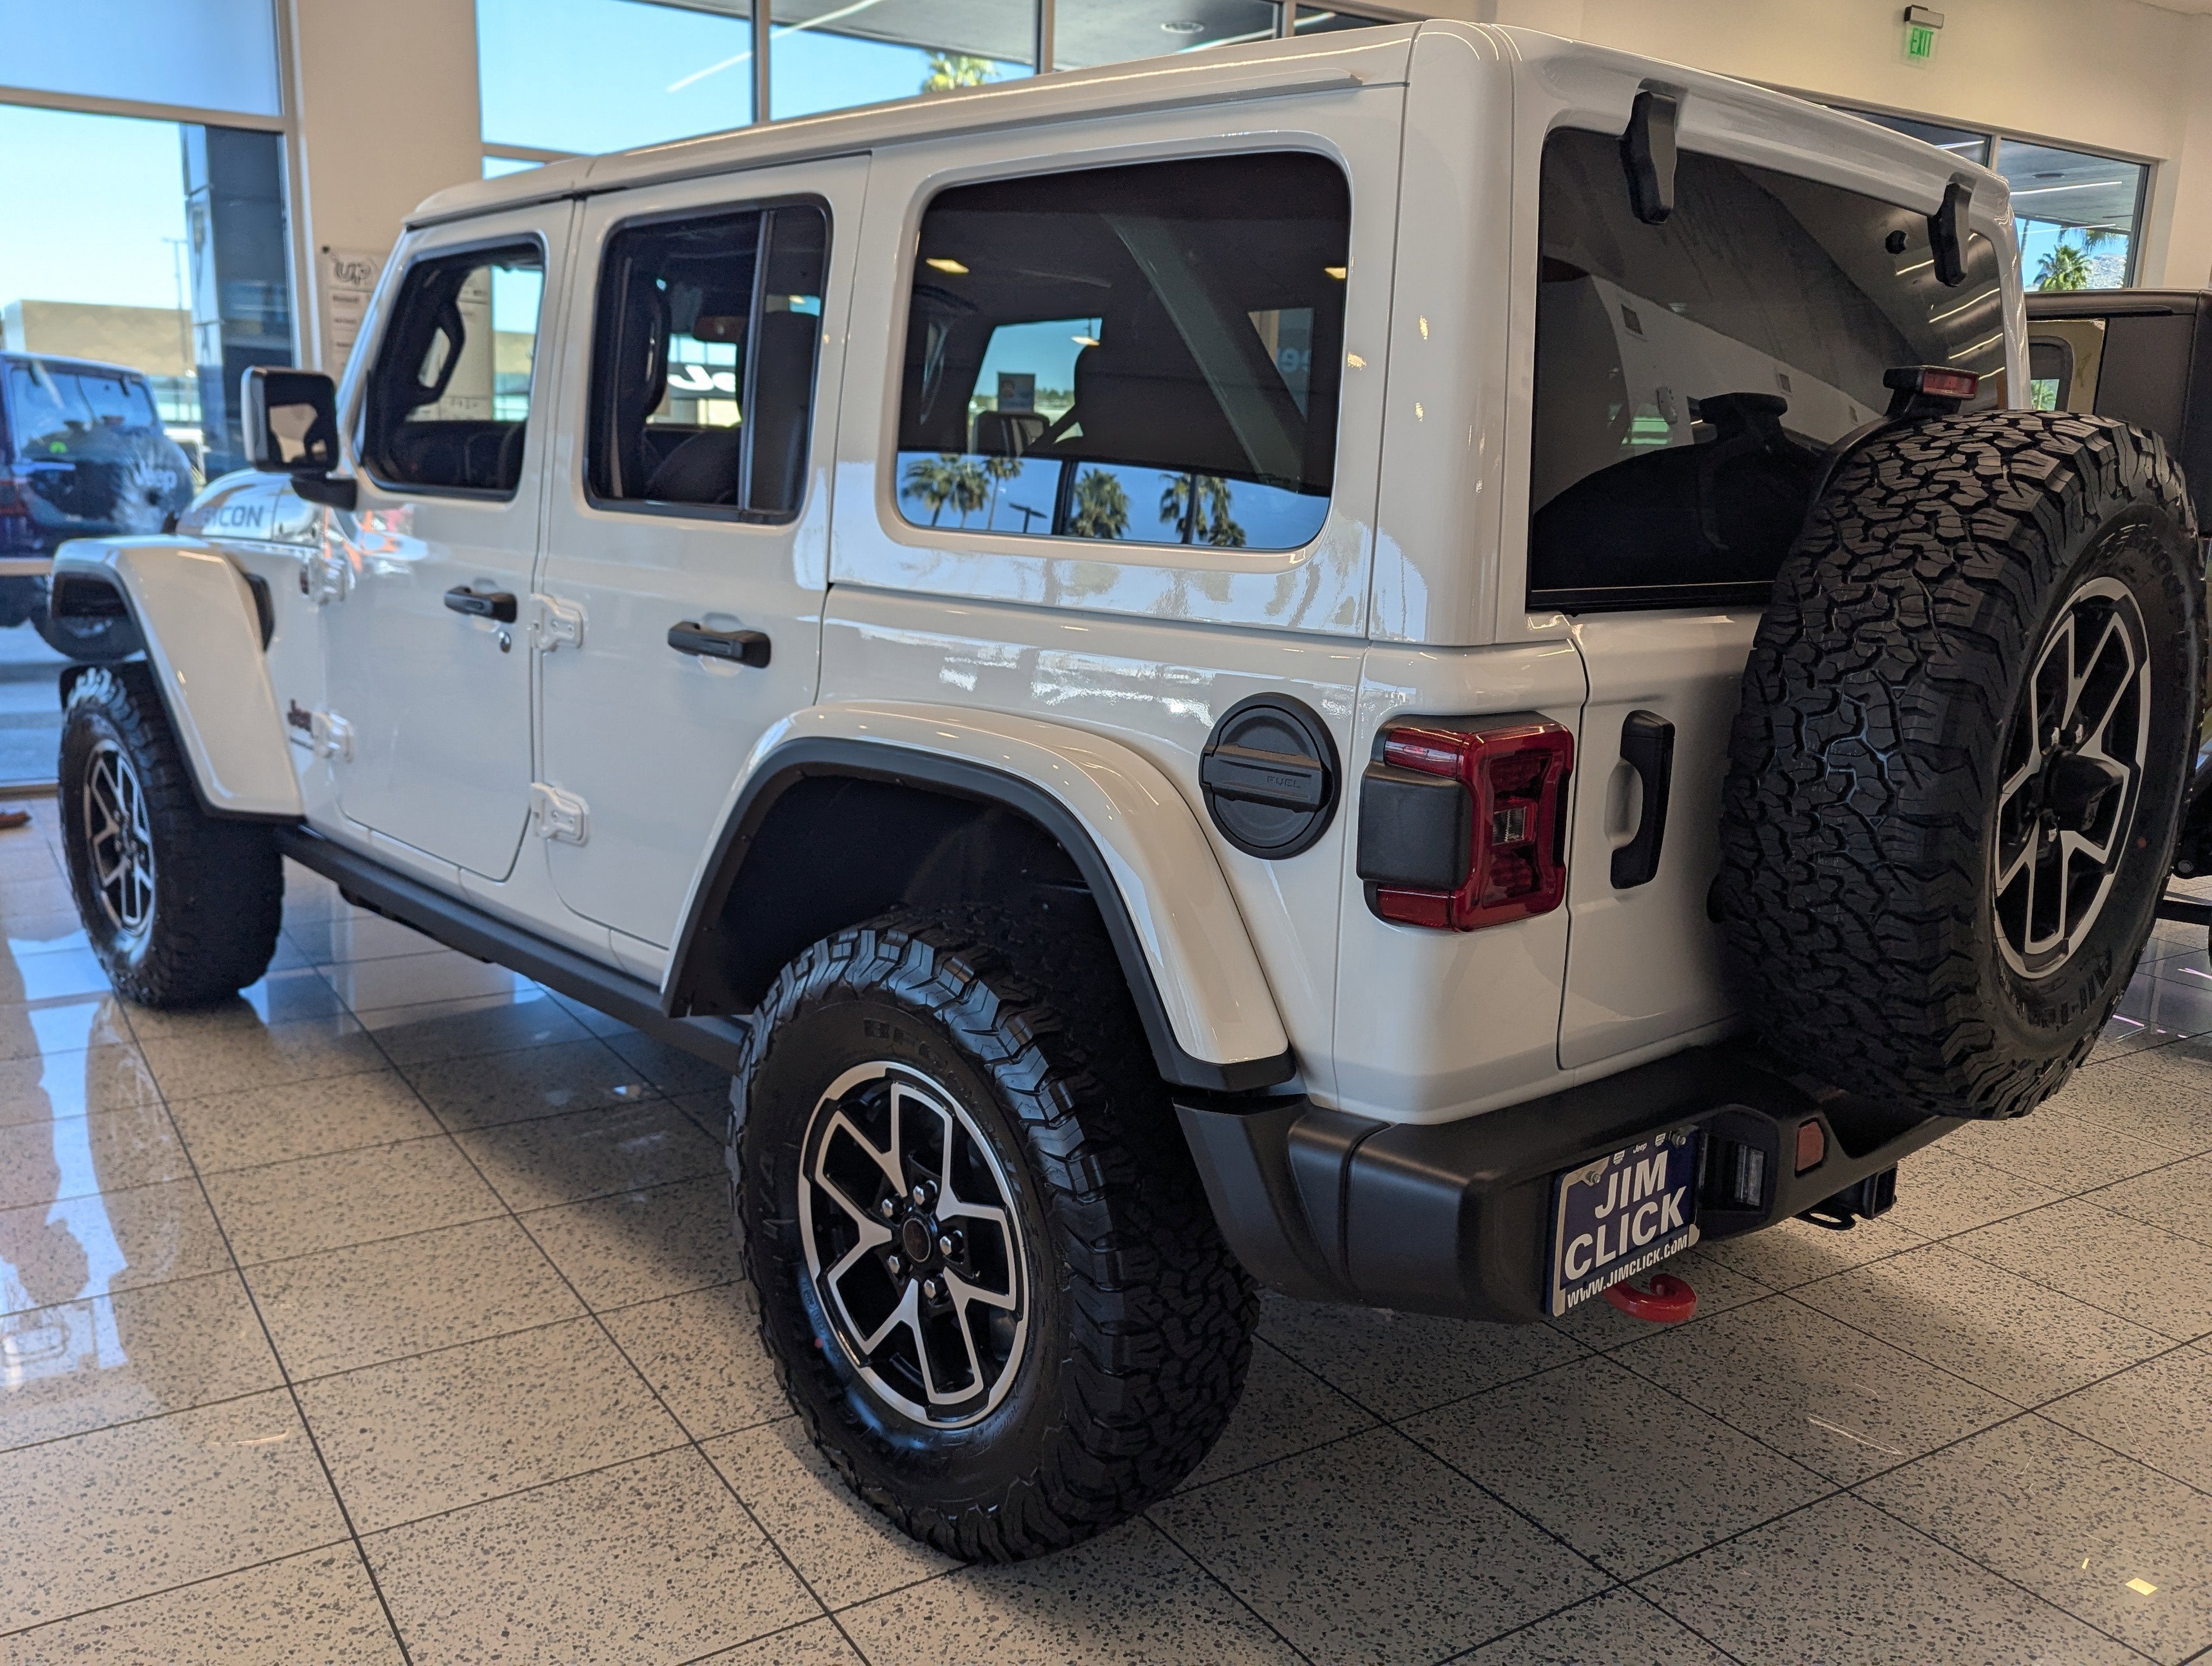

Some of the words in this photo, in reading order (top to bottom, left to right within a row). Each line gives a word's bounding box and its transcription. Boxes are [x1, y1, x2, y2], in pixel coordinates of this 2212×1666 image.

[1909, 27, 1934, 57] EXIT
[1266, 776, 1301, 789] FUEL
[1633, 1142, 1648, 1154] Jeep
[1594, 1150, 1669, 1219] JIM
[1565, 1186, 1687, 1280] CLICK
[1567, 1234, 1688, 1309] WWW.JIMCLICK.COM
